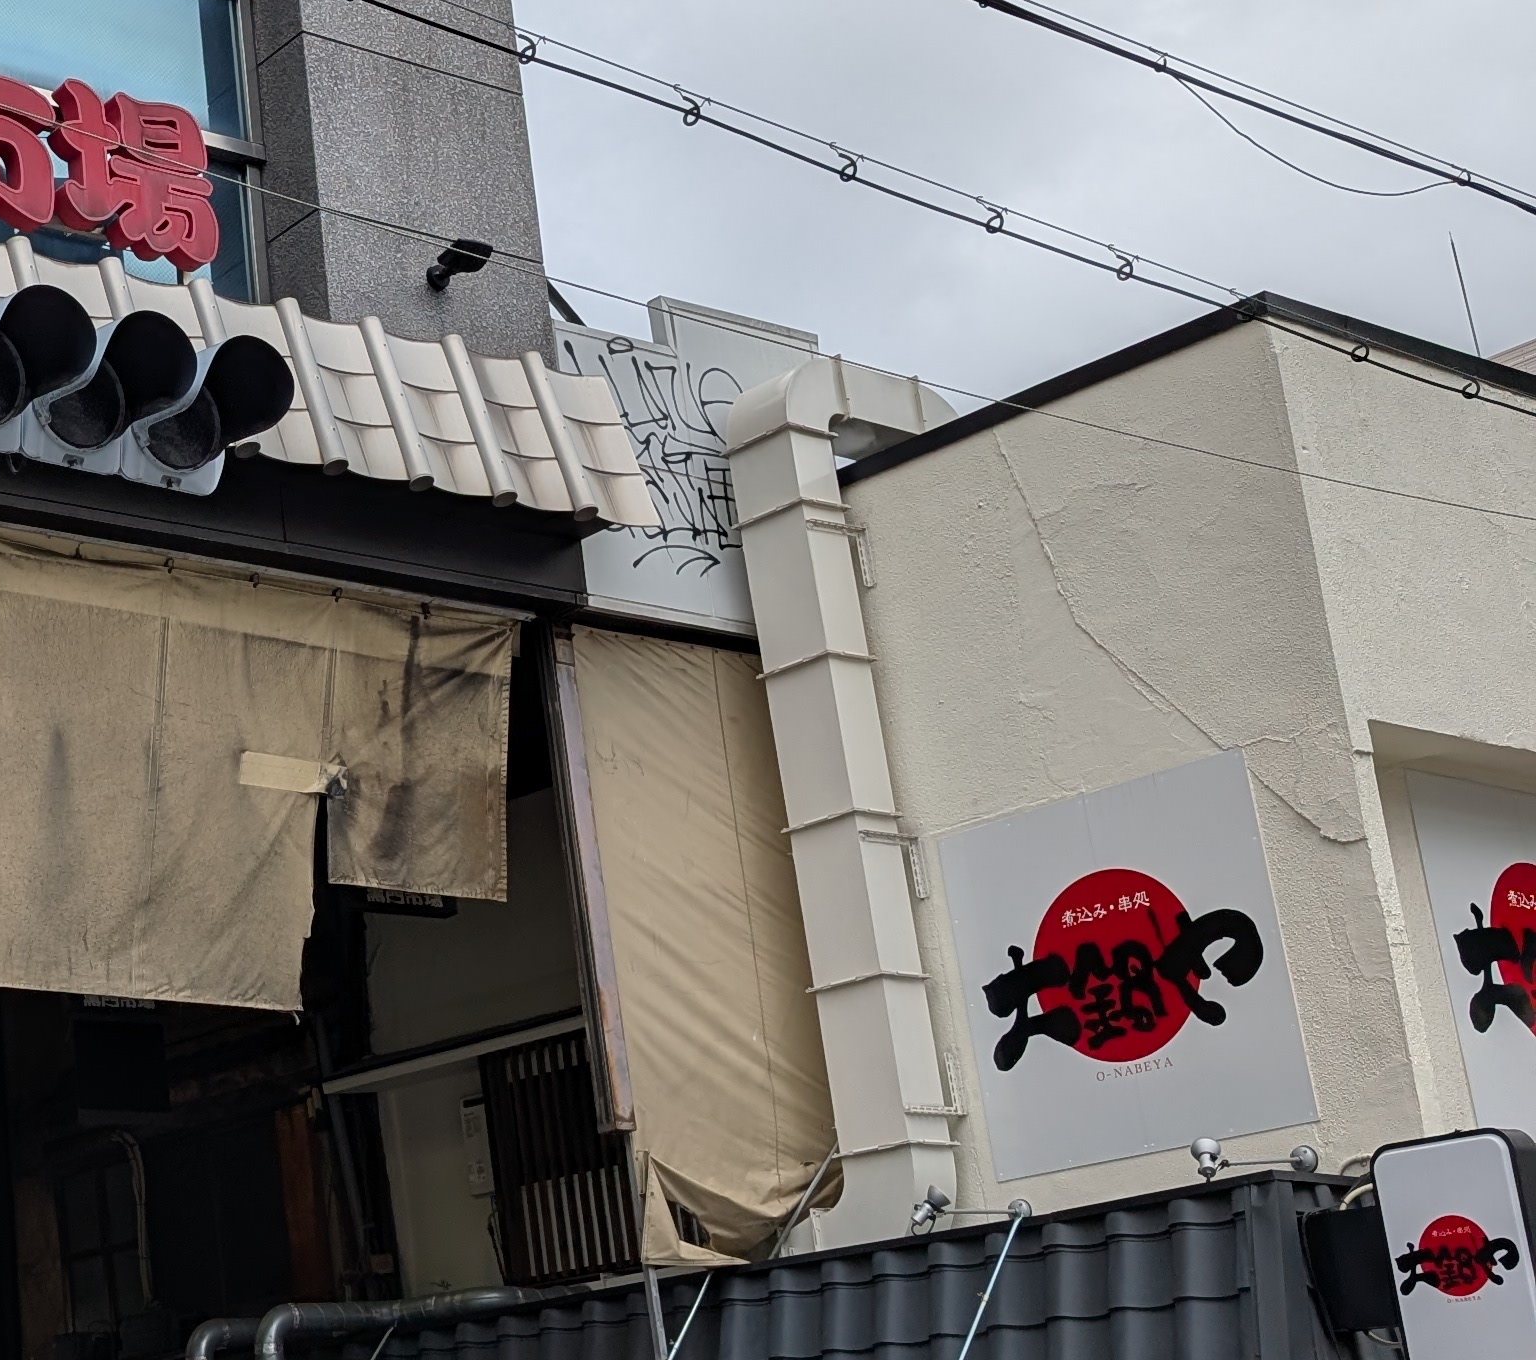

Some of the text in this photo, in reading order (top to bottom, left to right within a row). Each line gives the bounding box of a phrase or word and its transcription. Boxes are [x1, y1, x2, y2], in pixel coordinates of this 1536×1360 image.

[1061, 890, 1150, 929] 煮込み・串処
[1452, 902, 1536, 1037] 大
[1096, 1056, 1174, 1082] O-NABEYA
